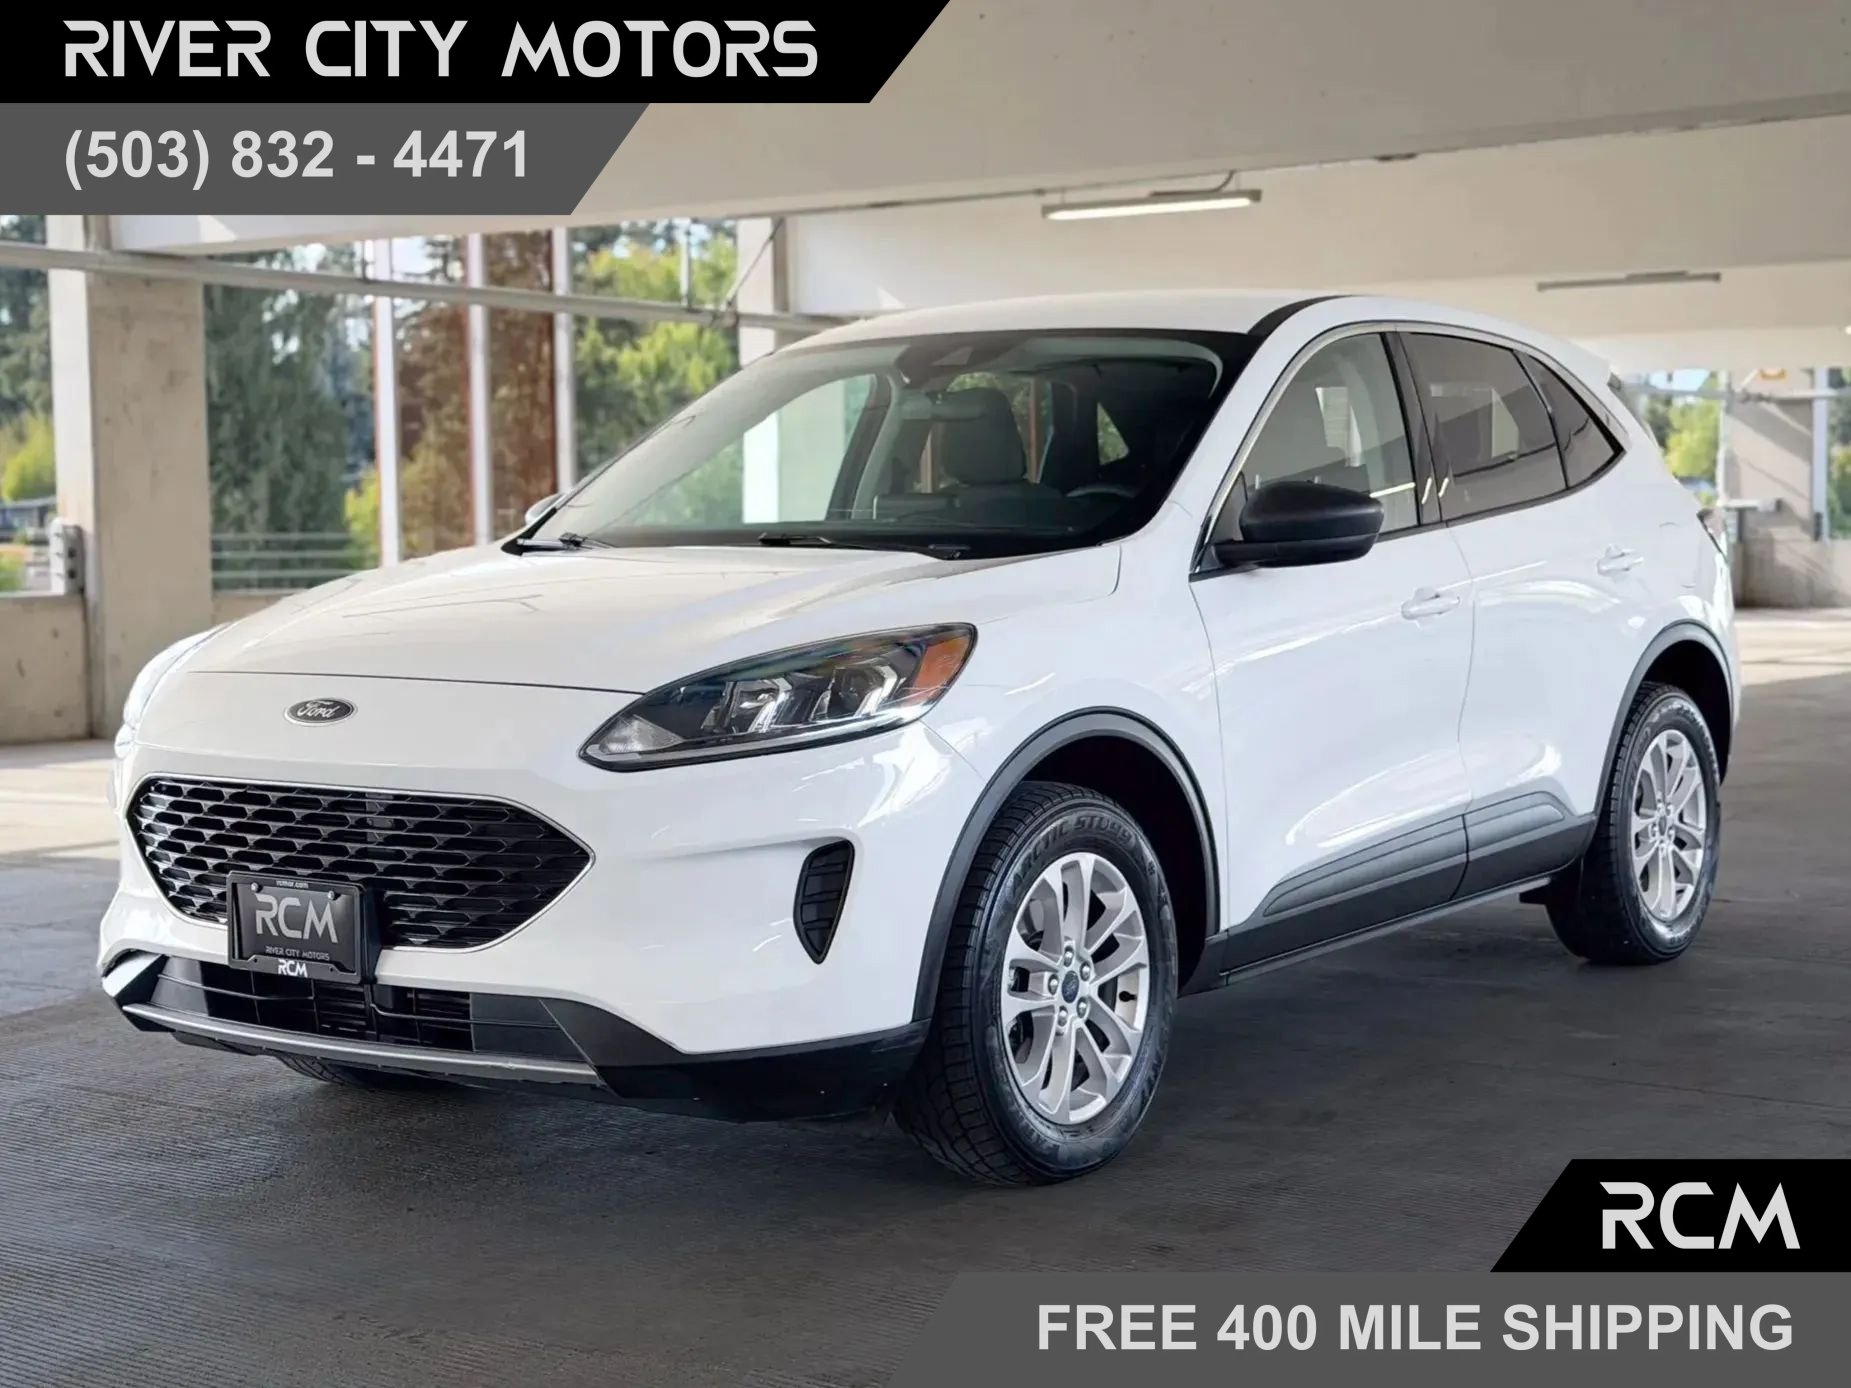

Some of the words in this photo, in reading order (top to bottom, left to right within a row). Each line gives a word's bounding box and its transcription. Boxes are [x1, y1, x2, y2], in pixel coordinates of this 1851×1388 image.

[297, 700, 340, 718] Ford
[255, 893, 338, 943] RCM
[265, 945, 284, 956] RIVER
[285, 948, 300, 957] CITY
[302, 951, 330, 961] MOTORS
[278, 959, 308, 978] RCM
